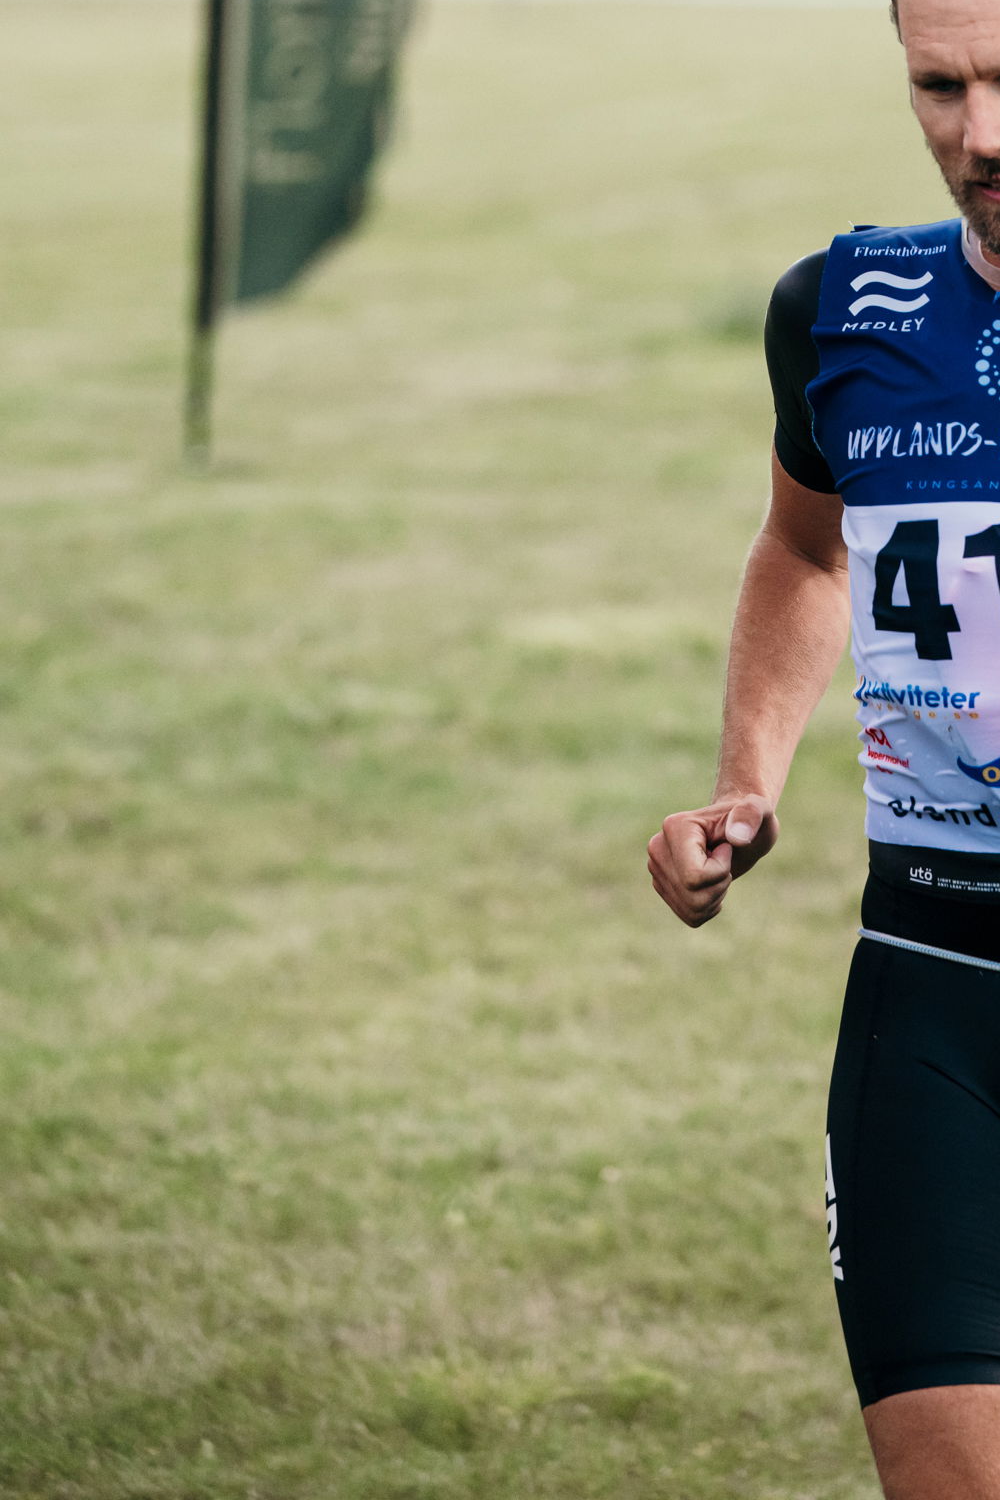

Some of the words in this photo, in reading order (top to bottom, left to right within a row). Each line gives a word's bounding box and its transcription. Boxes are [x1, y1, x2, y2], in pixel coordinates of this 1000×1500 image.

[854, 244, 947, 258] Floristhörnan
[842, 317, 925, 332] MEDLEY
[909, 866, 933, 881] utö
